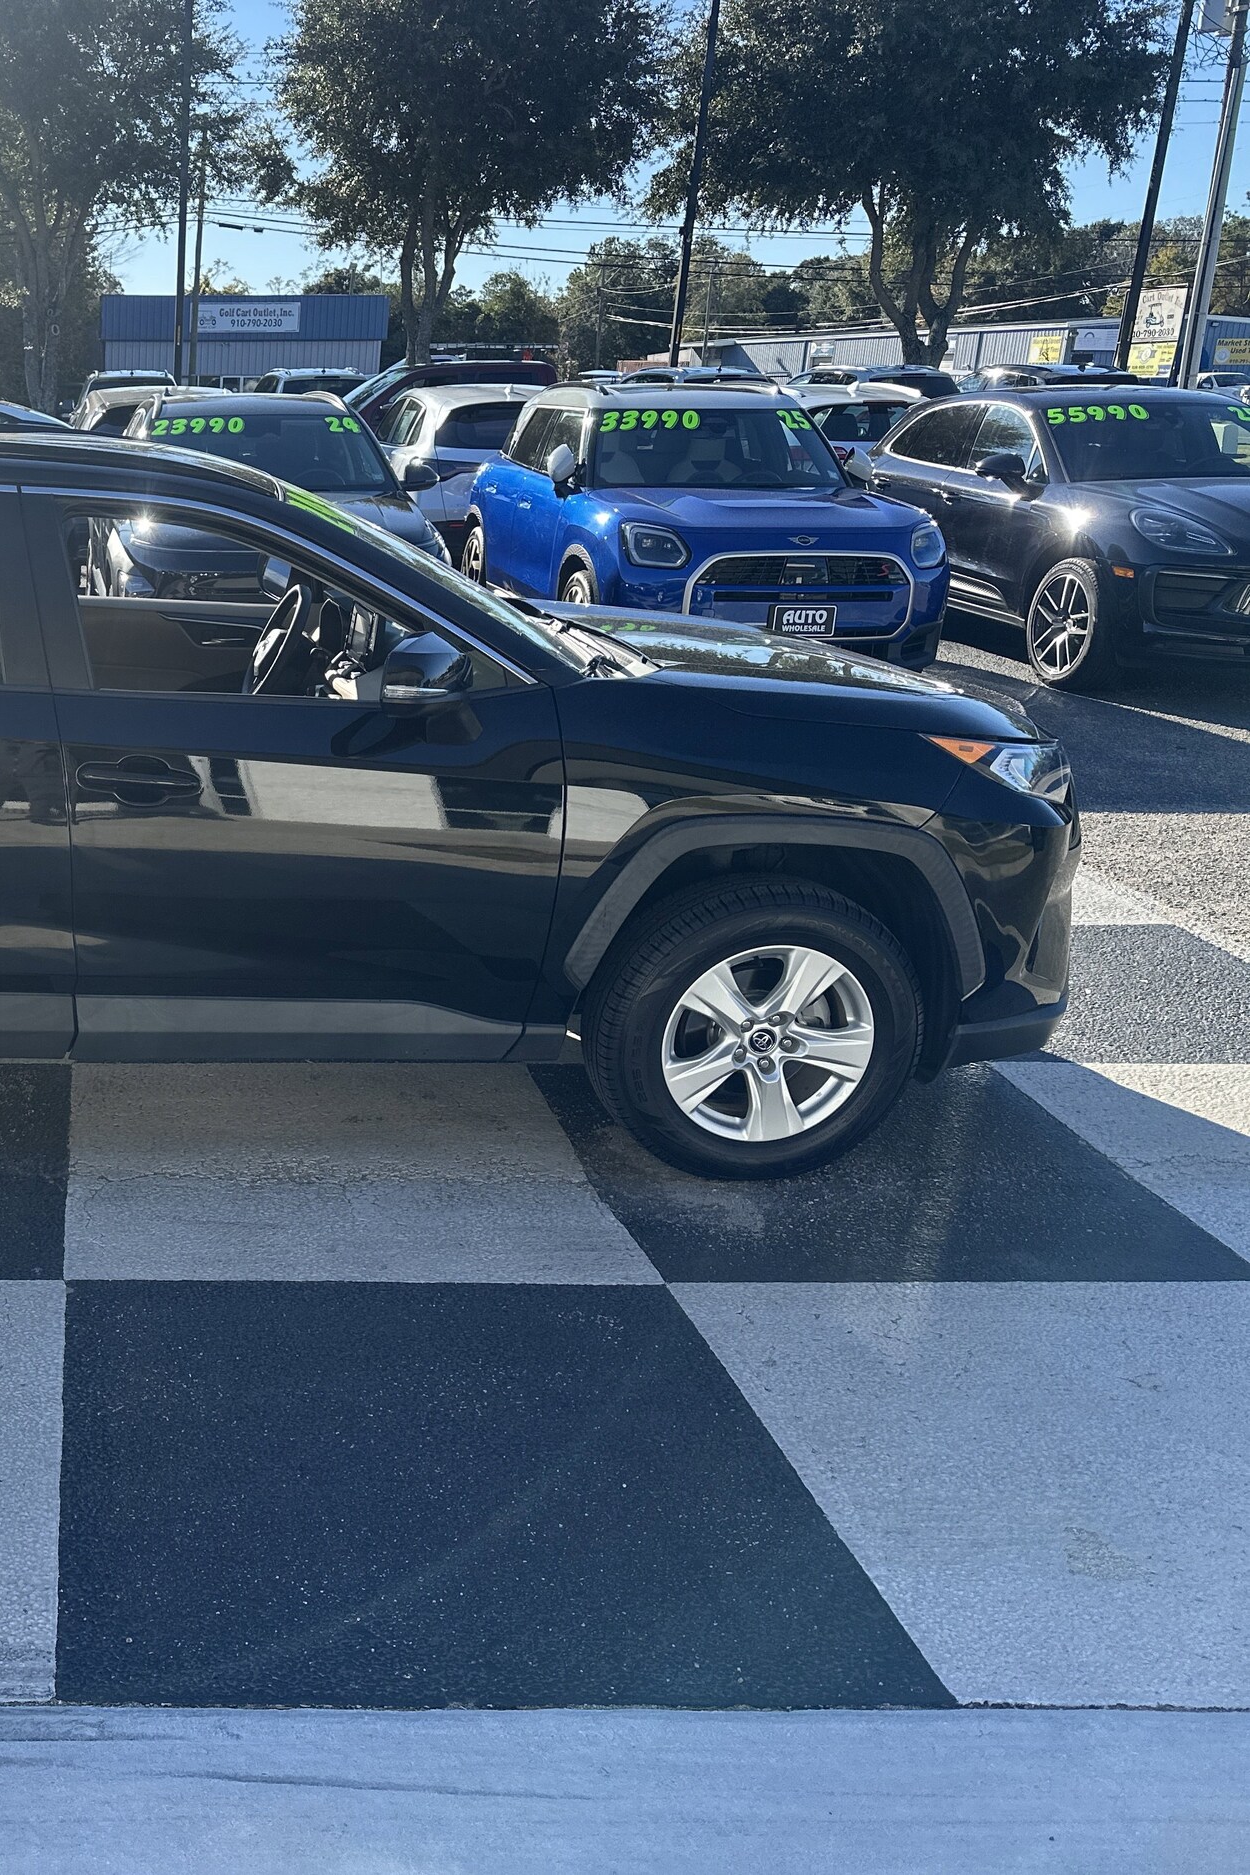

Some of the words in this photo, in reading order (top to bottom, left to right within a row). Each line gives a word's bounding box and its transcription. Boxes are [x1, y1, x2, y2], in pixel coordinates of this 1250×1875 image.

[1142, 293, 1156, 304] Cart
[219, 308, 235, 317] Golf
[236, 308, 251, 317] Cart
[252, 308, 279, 319] Outlet,
[279, 308, 294, 317] Inc.
[230, 318, 283, 328] 910-790-2030
[1132, 327, 1175, 338] 10-790-2030
[1217, 339, 1242, 347] Market
[1047, 404, 1149, 425] 55990
[151, 417, 245, 436] 23990
[324, 416, 361, 434] 24
[600, 410, 700, 432] 33990
[776, 409, 812, 431] 25
[782, 609, 828, 625] AUTO
[781, 624, 826, 633] WHOLESALE
